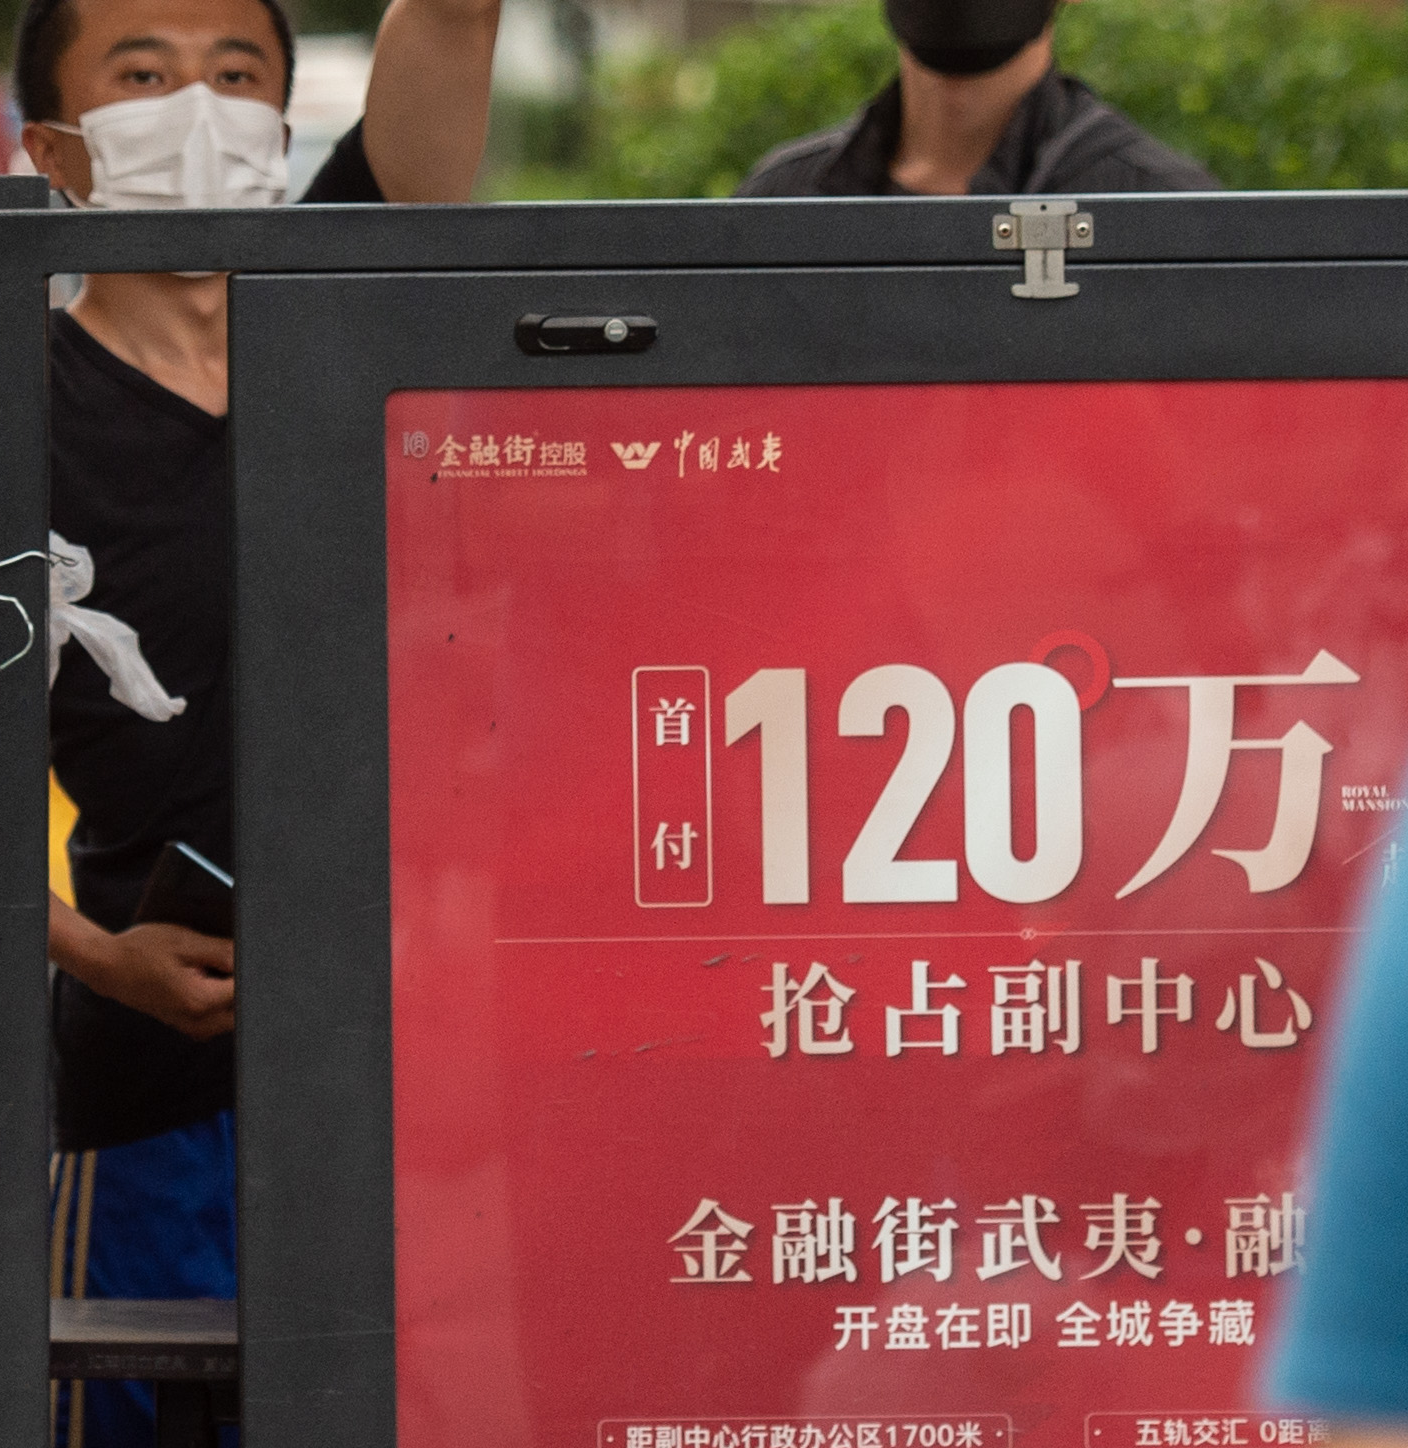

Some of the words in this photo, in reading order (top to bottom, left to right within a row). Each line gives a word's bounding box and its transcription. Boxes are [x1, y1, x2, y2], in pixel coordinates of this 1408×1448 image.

[673, 429, 783, 478] 中国武夷
[649, 697, 698, 871] 首付
[759, 956, 1313, 1058] 抢占副中心
[833, 1306, 1031, 1351] 开盘在即
[1055, 1299, 1256, 1348] 全城争藏
[626, 1421, 983, 1448] 距副中心行政办公区1700米
[1135, 1418, 1249, 1446] 五轨交汇
